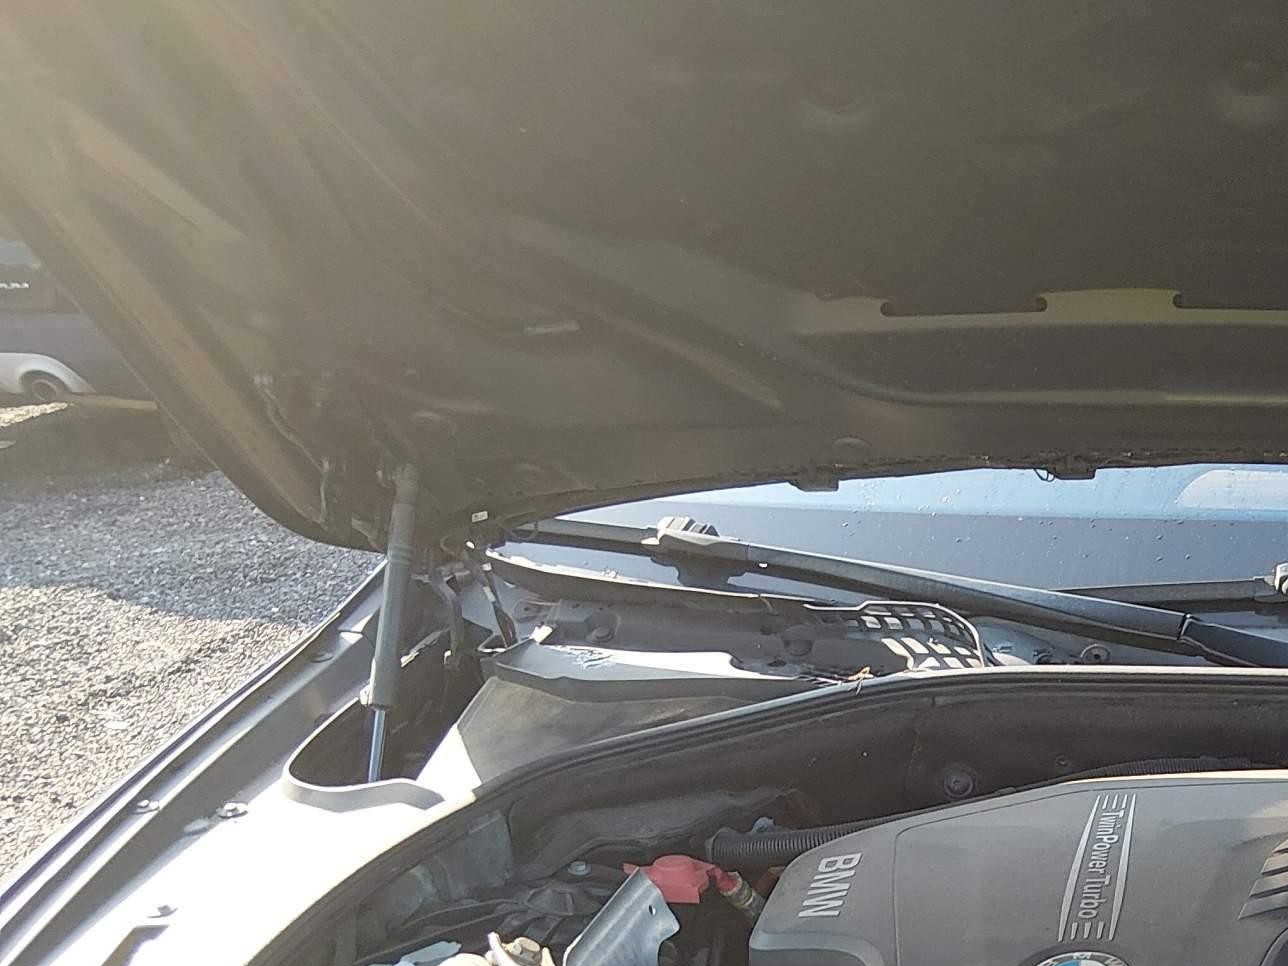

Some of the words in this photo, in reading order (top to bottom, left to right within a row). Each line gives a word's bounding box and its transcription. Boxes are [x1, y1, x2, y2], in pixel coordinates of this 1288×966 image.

[1088, 809, 1125, 874] TwinPower
[798, 852, 863, 918] BMW
[1078, 874, 1111, 919] Turbo
